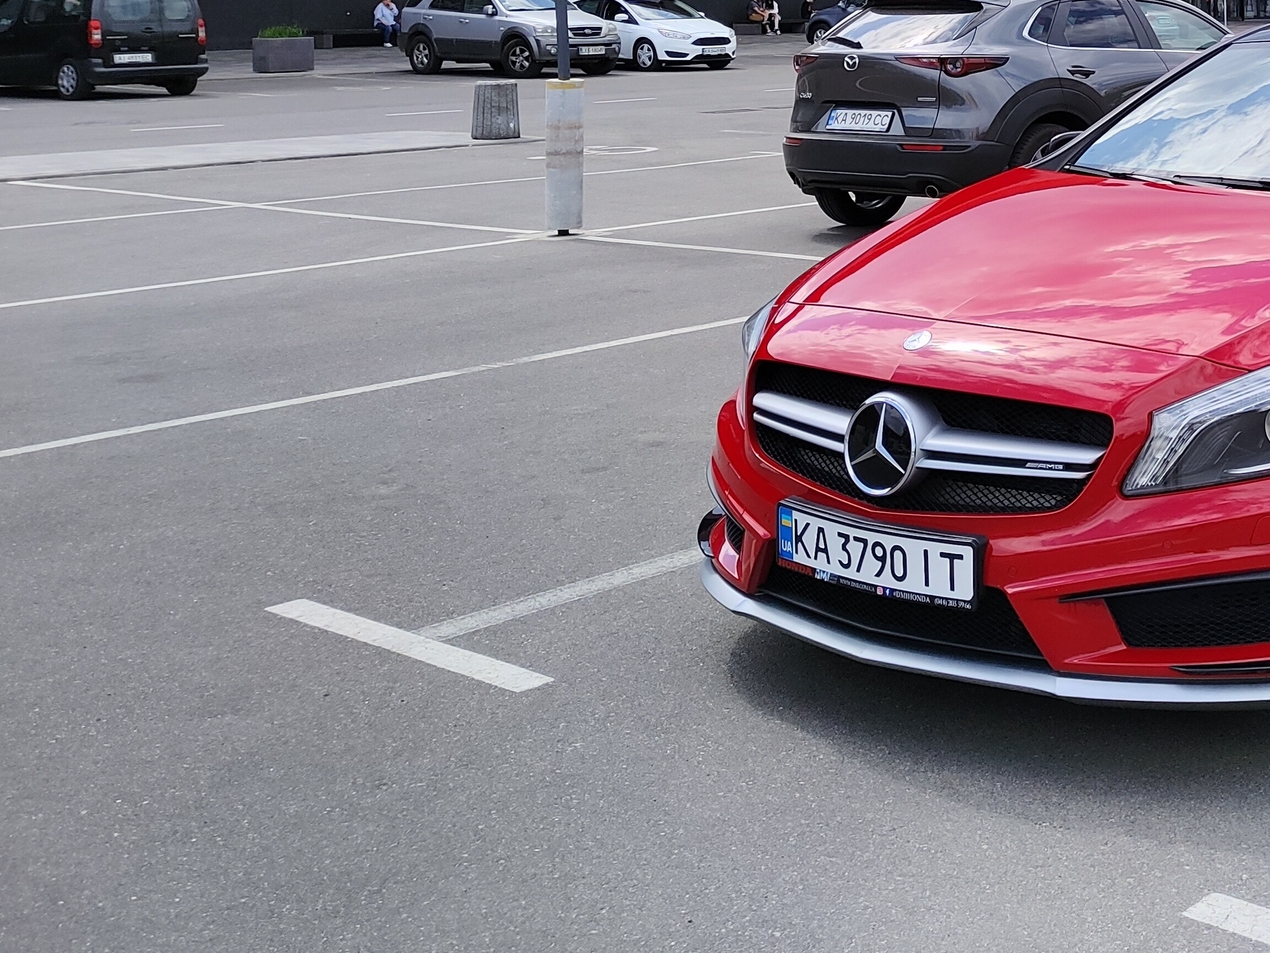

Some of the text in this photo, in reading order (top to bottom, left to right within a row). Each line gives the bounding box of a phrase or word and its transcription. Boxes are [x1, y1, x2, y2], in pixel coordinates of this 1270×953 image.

[833, 112, 889, 127] KA 9019 CC
[782, 541, 792, 553] UA
[794, 518, 964, 592] KA 3790 IT
[778, 558, 814, 577] HONDA
